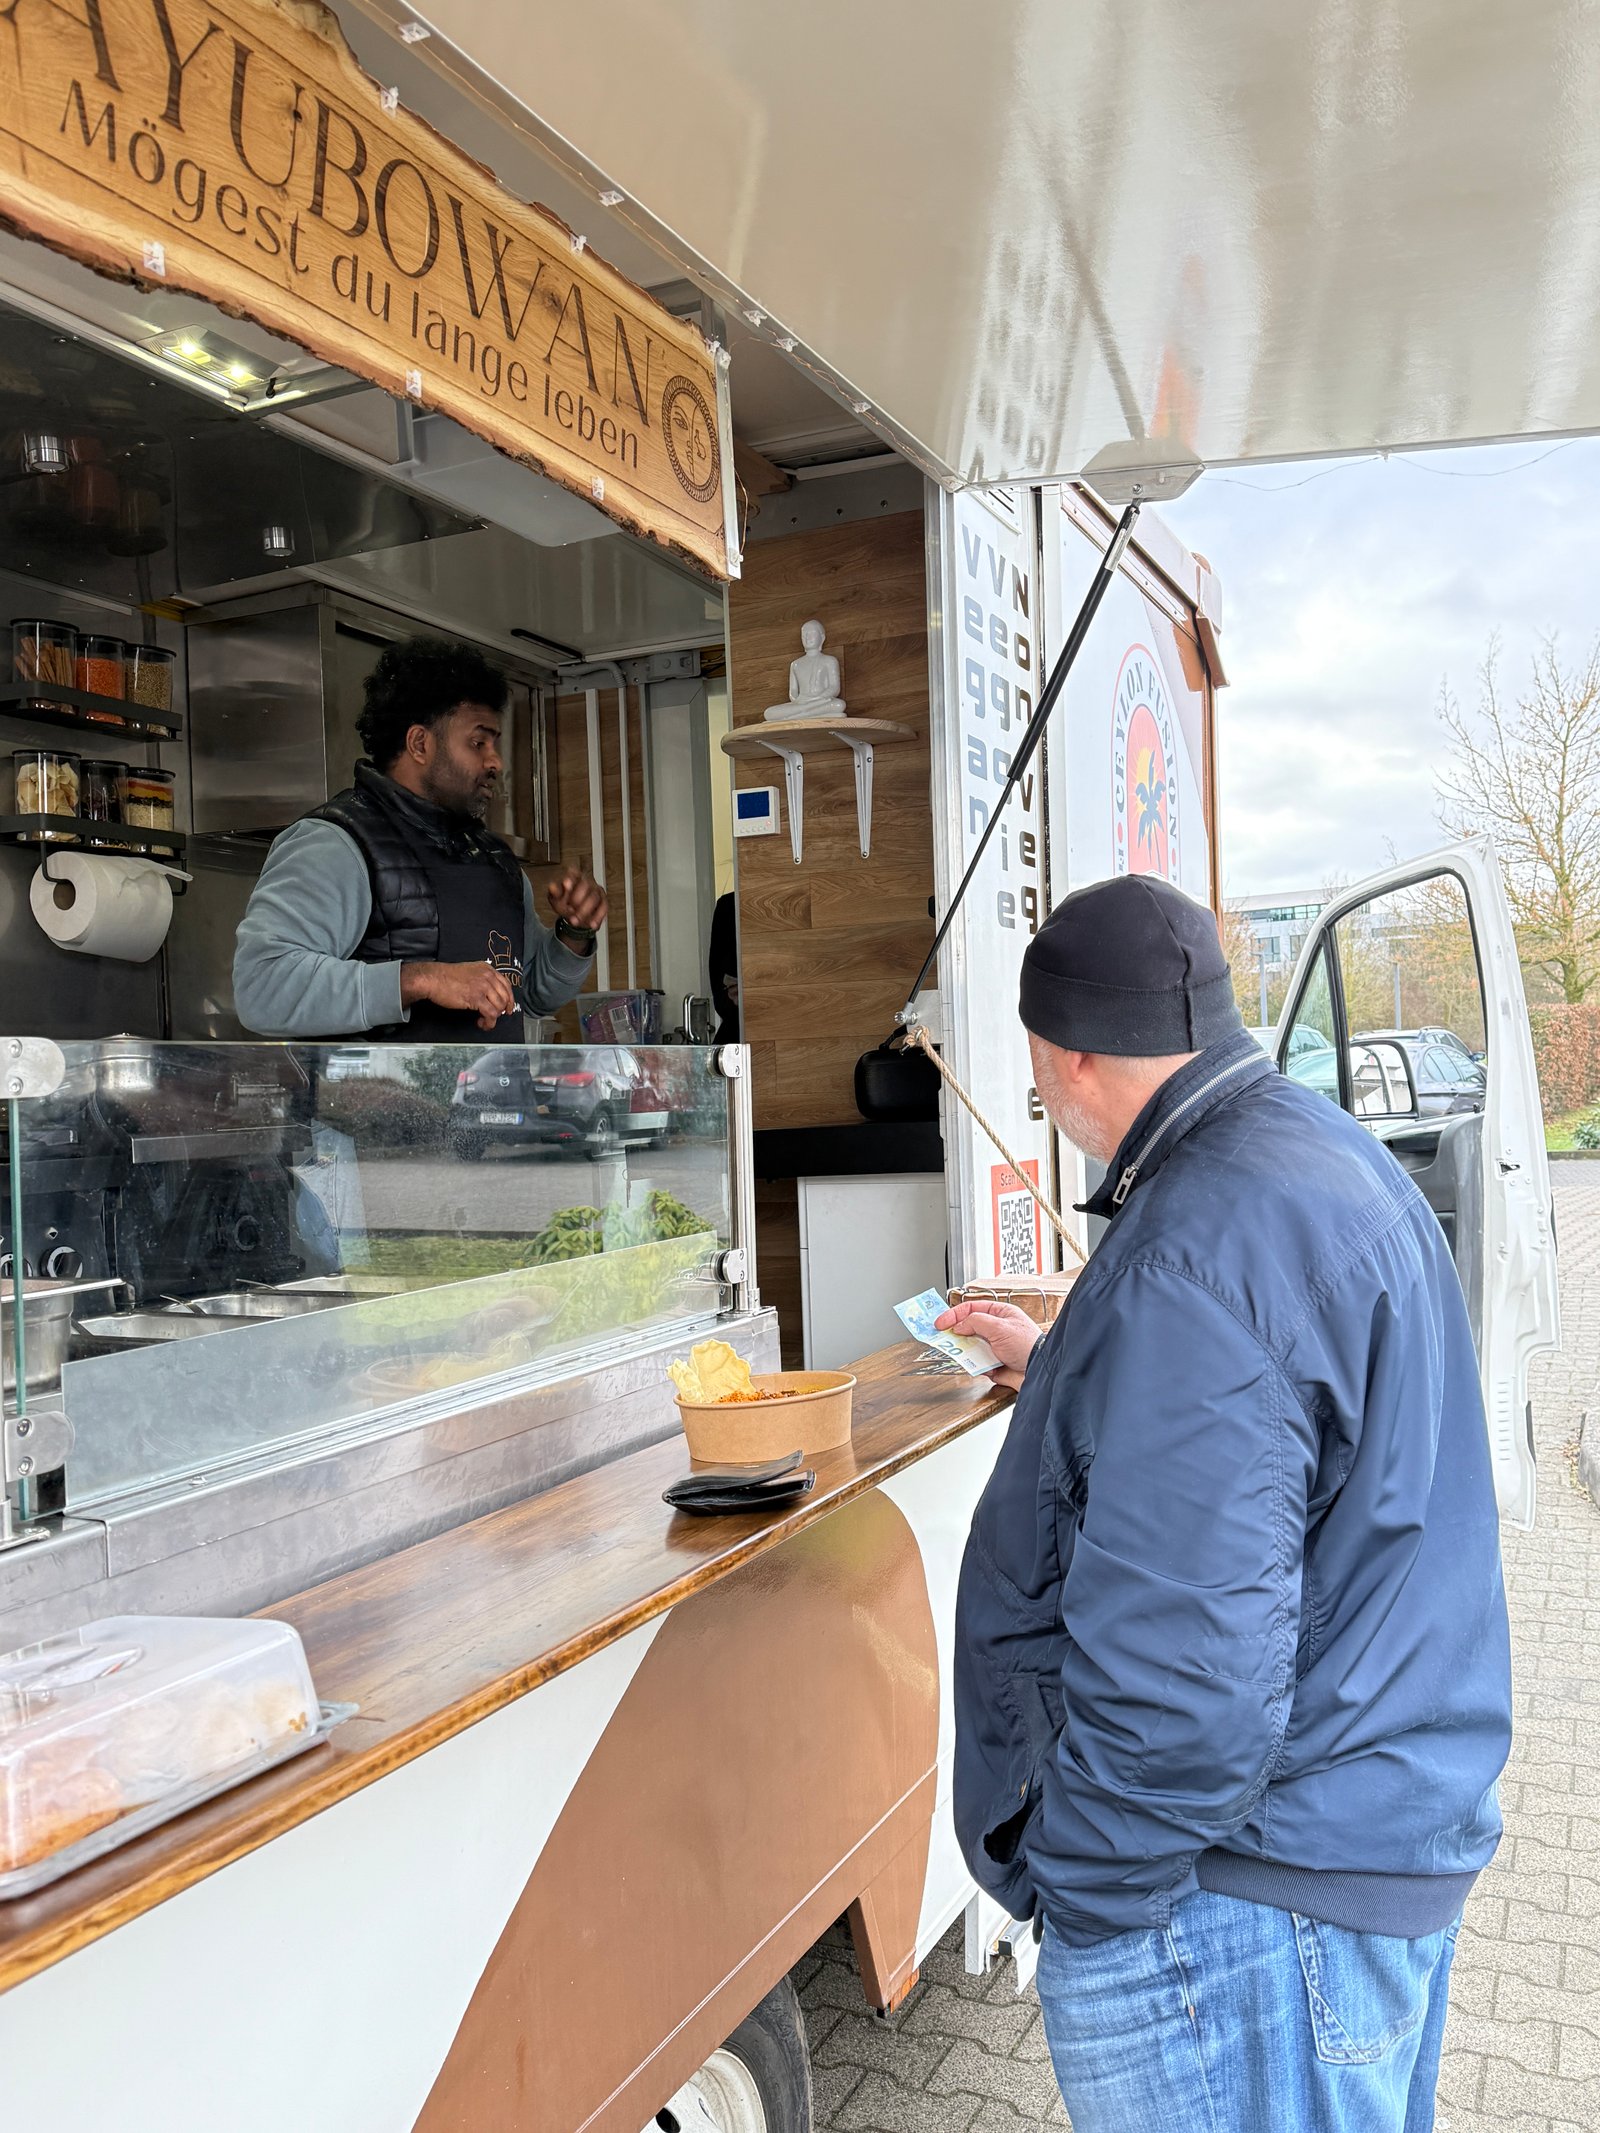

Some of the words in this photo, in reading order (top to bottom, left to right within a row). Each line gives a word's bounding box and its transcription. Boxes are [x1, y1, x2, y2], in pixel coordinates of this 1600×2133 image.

[60, 79, 309, 275] Mögest
[331, 250, 391, 324] du
[411, 290, 529, 401] lange
[544, 383, 640, 469] leben
[1115, 661, 1144, 813] CEYLON
[1148, 670, 1177, 839] FUSION
[1000, 1172, 1016, 1187] Scan
[938, 1340, 964, 1356] 20
